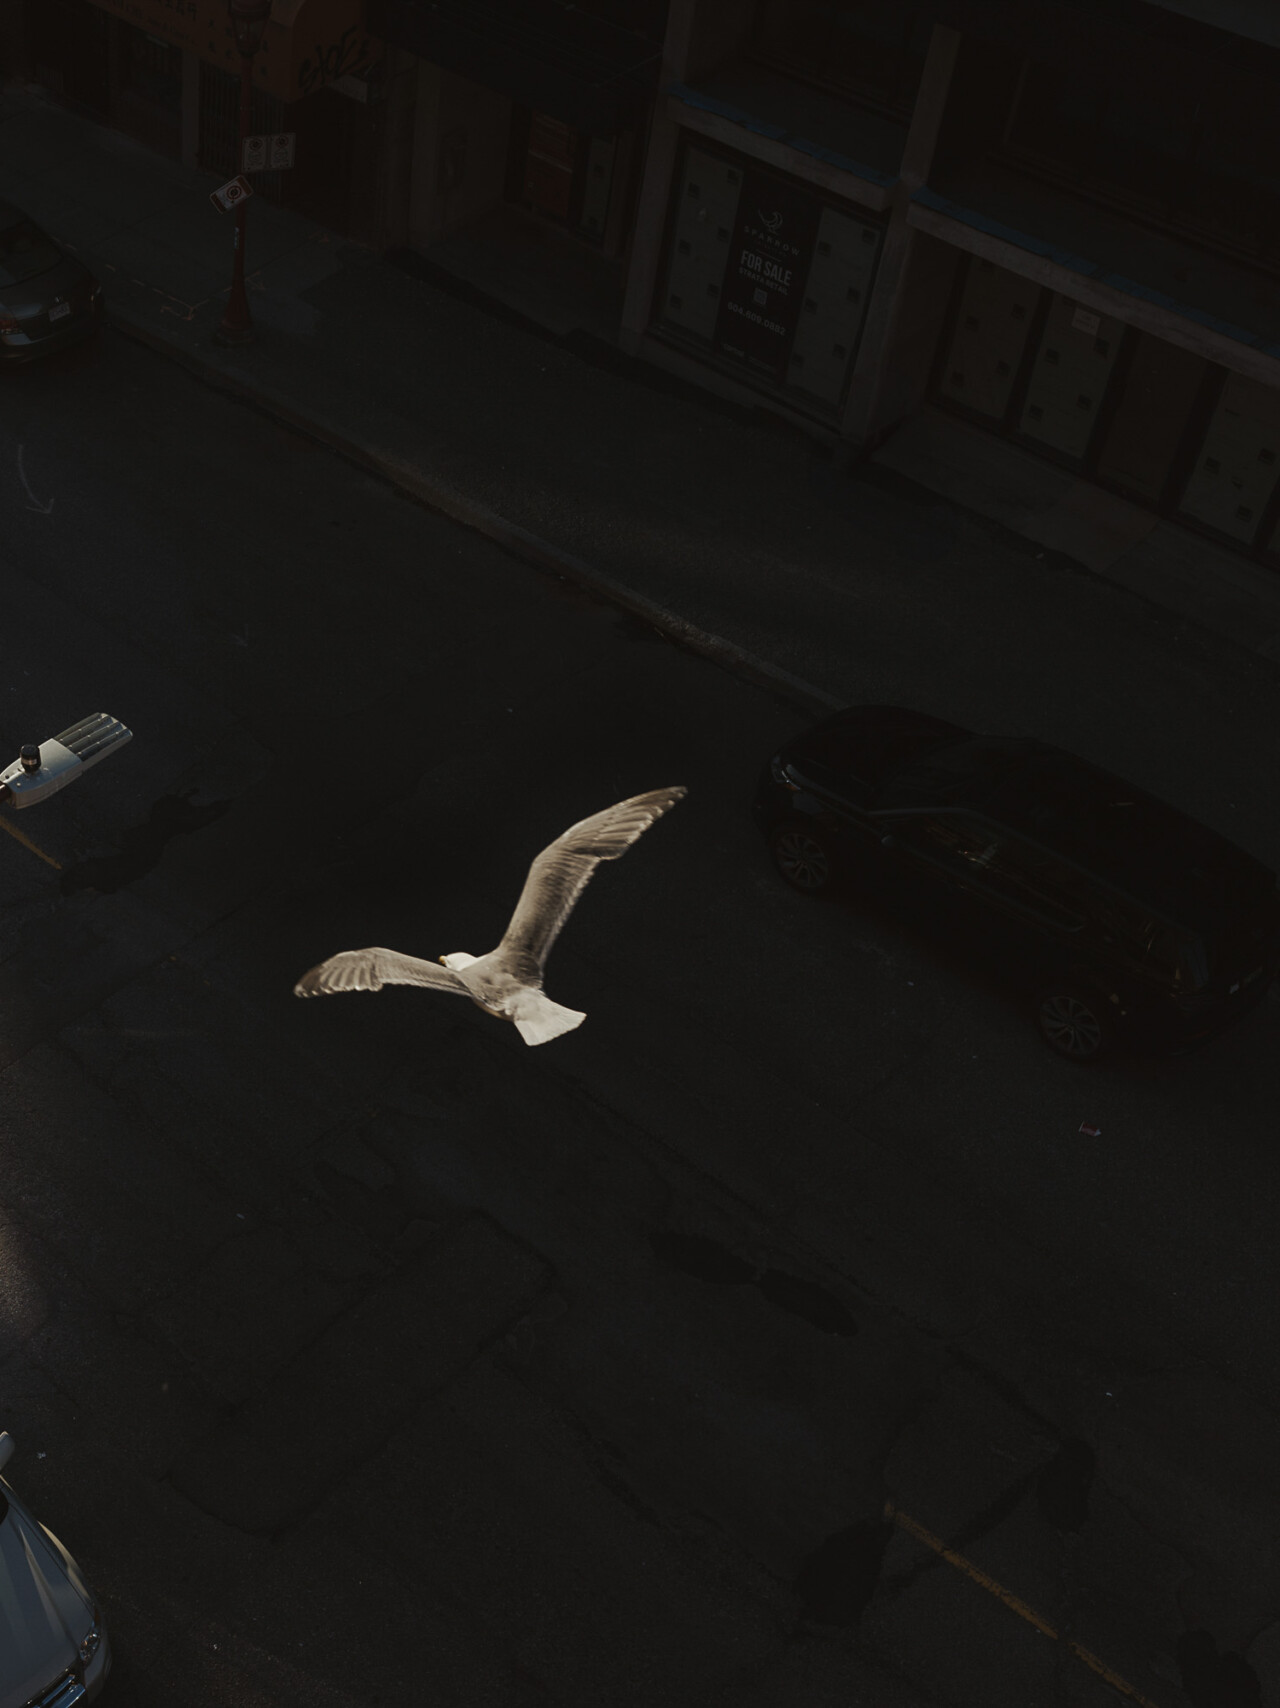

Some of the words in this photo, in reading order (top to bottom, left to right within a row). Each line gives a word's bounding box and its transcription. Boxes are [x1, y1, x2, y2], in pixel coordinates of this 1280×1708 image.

[744, 225, 800, 256] SPARROW
[739, 266, 764, 283] STRATA
[765, 279, 788, 296] RETAIL
[740, 250, 762, 273] FOR
[764, 261, 792, 286] SALE
